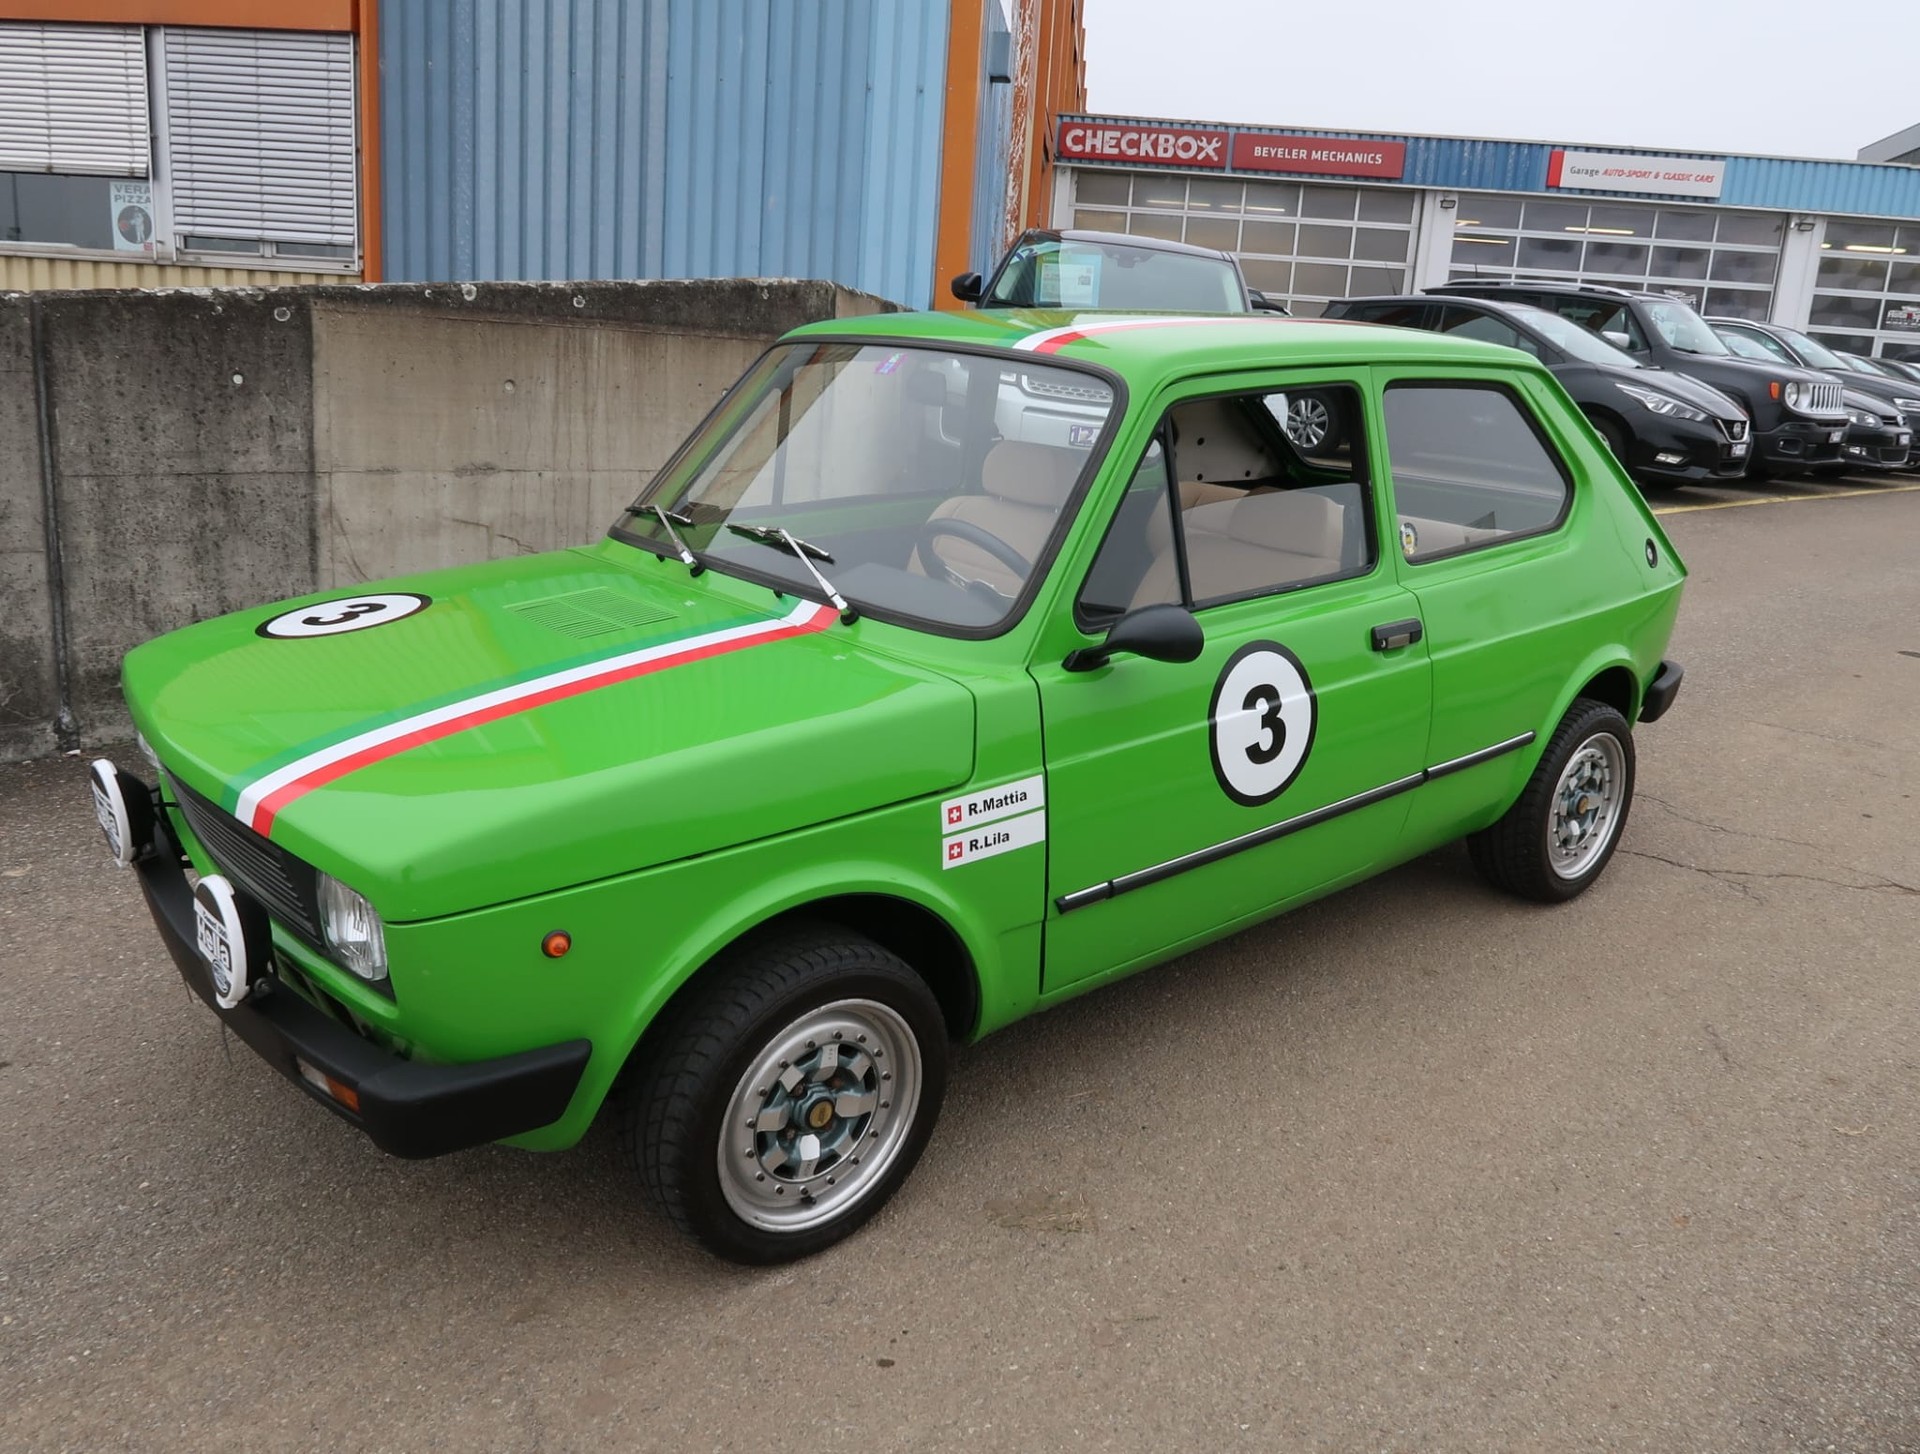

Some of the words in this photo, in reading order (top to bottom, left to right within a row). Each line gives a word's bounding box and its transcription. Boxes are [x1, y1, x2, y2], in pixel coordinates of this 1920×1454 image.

[1065, 128, 1222, 161] CHECKBOX
[1254, 146, 1307, 160] BEYELER
[1311, 149, 1383, 164] MECHANICS
[1570, 166, 1600, 176] Garage
[1602, 168, 1652, 178] AUTO-SPORT
[1663, 172, 1693, 181] CLASSIC
[1694, 174, 1715, 183] CARS
[114, 184, 150, 194] VERA
[114, 194, 151, 204] PIZZA
[302, 603, 387, 626] 3
[1242, 683, 1287, 765] 3
[968, 790, 1028, 816] R.Mattia
[969, 832, 1010, 852] R.Lila
